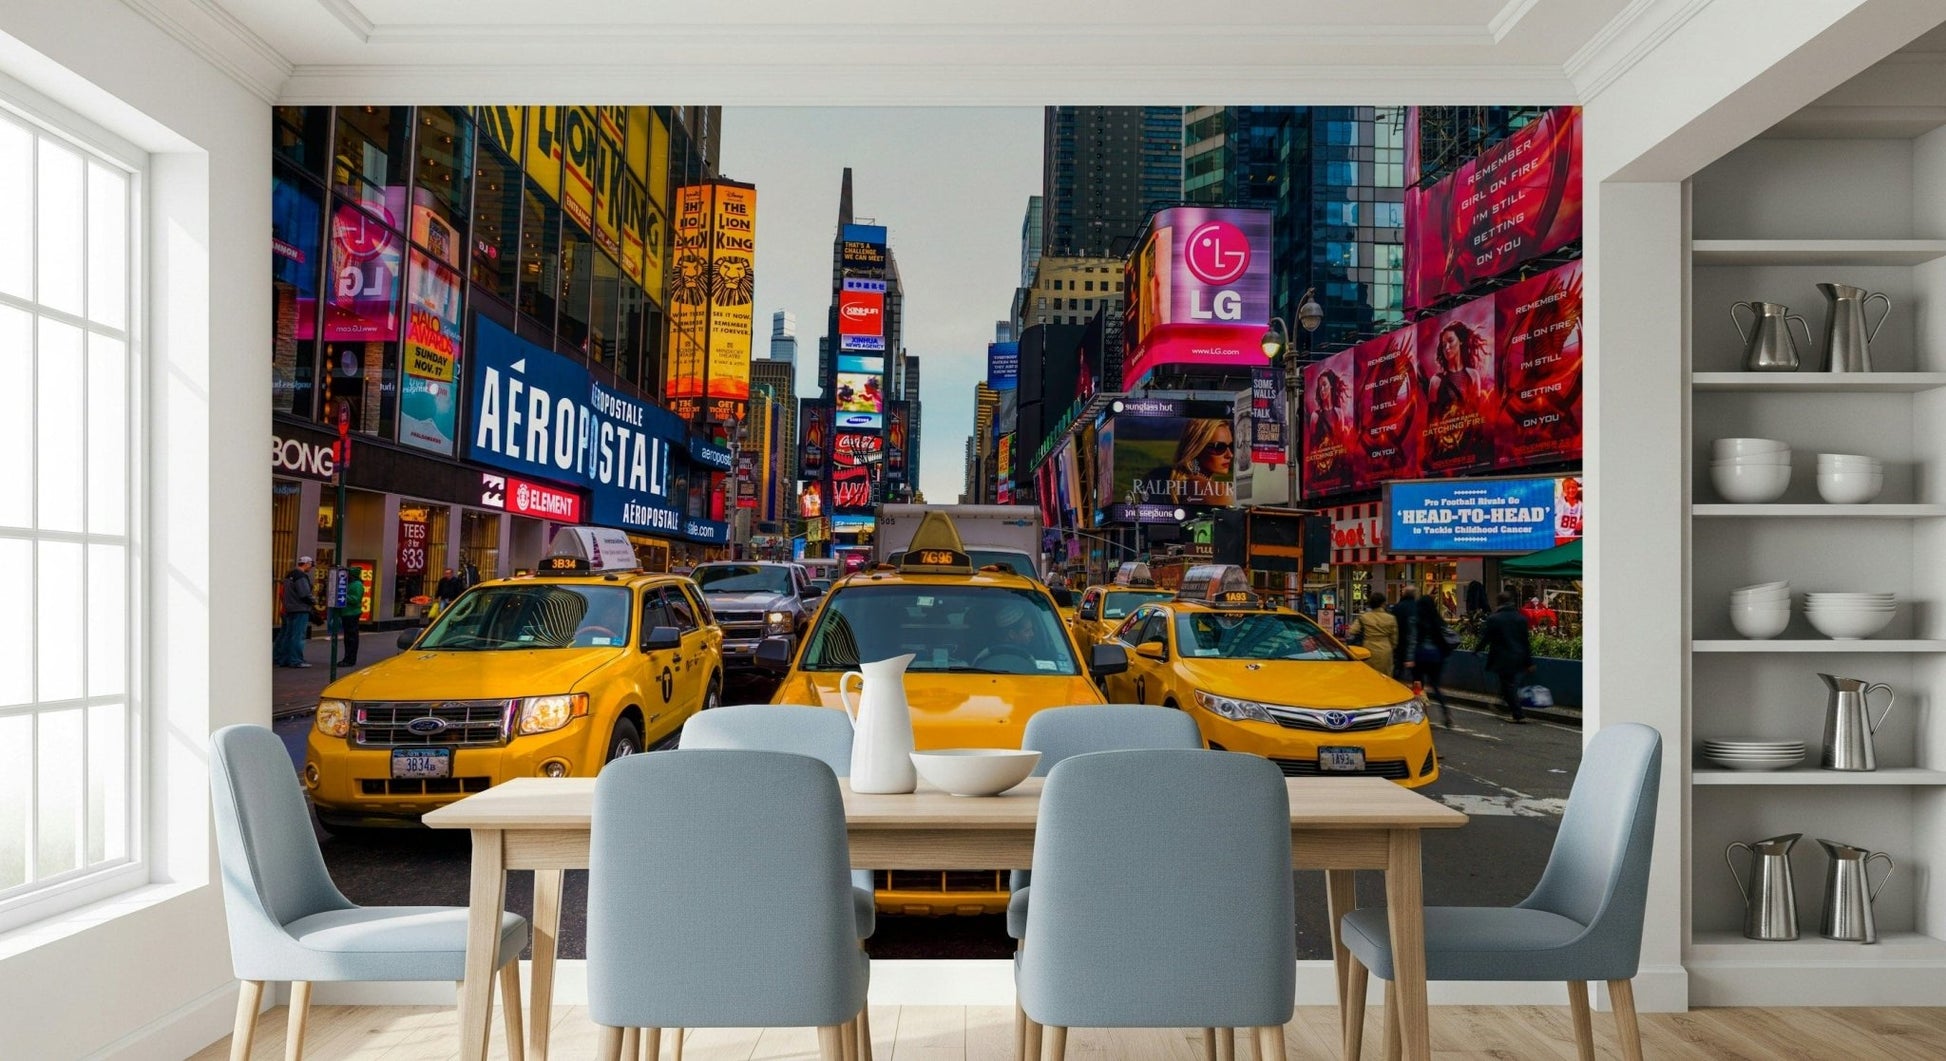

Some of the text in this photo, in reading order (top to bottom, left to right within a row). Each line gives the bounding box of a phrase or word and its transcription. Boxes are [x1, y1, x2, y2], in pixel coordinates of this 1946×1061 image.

[1468, 139, 1532, 185] REMEMBER
[1461, 158, 1539, 210] GIRL ON FIRE
[566, 194, 591, 227] ENTRANCE
[723, 202, 746, 213] THE
[1472, 191, 1526, 225] I'M STILL
[719, 213, 750, 229] LION
[1474, 212, 1524, 246] BETTING
[716, 231, 753, 249] KING
[1477, 237, 1522, 266] ON YOU
[1190, 290, 1242, 320] LG
[1515, 290, 1567, 315] REMEMBER
[410, 305, 440, 333] HALO
[714, 320, 747, 328] REMEMBER
[408, 322, 453, 355] AWARDS
[1511, 319, 1571, 345] GIRL ON FIRE
[415, 346, 448, 366] SUNDAY
[1367, 351, 1401, 367] REMEMBER
[1520, 353, 1562, 370] I'M STILL
[414, 359, 443, 376] NOV. 17
[1253, 379, 1274, 389] SOME
[1364, 382, 1378, 390] GIRL
[1379, 378, 1389, 386] ON
[1520, 382, 1562, 399] BETTING
[1253, 389, 1277, 399] WALLS
[591, 380, 643, 428] AÉROPOSTALE
[718, 400, 734, 408] GET
[1124, 402, 1173, 412] sunglass hut
[1380, 400, 1397, 409] STILL
[1254, 408, 1271, 418] TALK
[1523, 413, 1559, 428] ON YOU
[1370, 424, 1397, 435] BETTING
[1422, 416, 1486, 437] CATCHING FIRE
[1372, 448, 1396, 458] ON YOU
[1132, 478, 1187, 496] RALPH
[530, 489, 573, 517] ELEMENT
[1424, 496, 1520, 506] Pro Football Rivals Go
[622, 498, 679, 531] AÉROPOSTALE
[403, 523, 426, 539] TEES
[1413, 526, 1533, 535] to Tackle Childhood Cancer
[402, 548, 424, 569] $33
[552, 558, 576, 569] 3B34
[1226, 592, 1247, 601] 1A93
